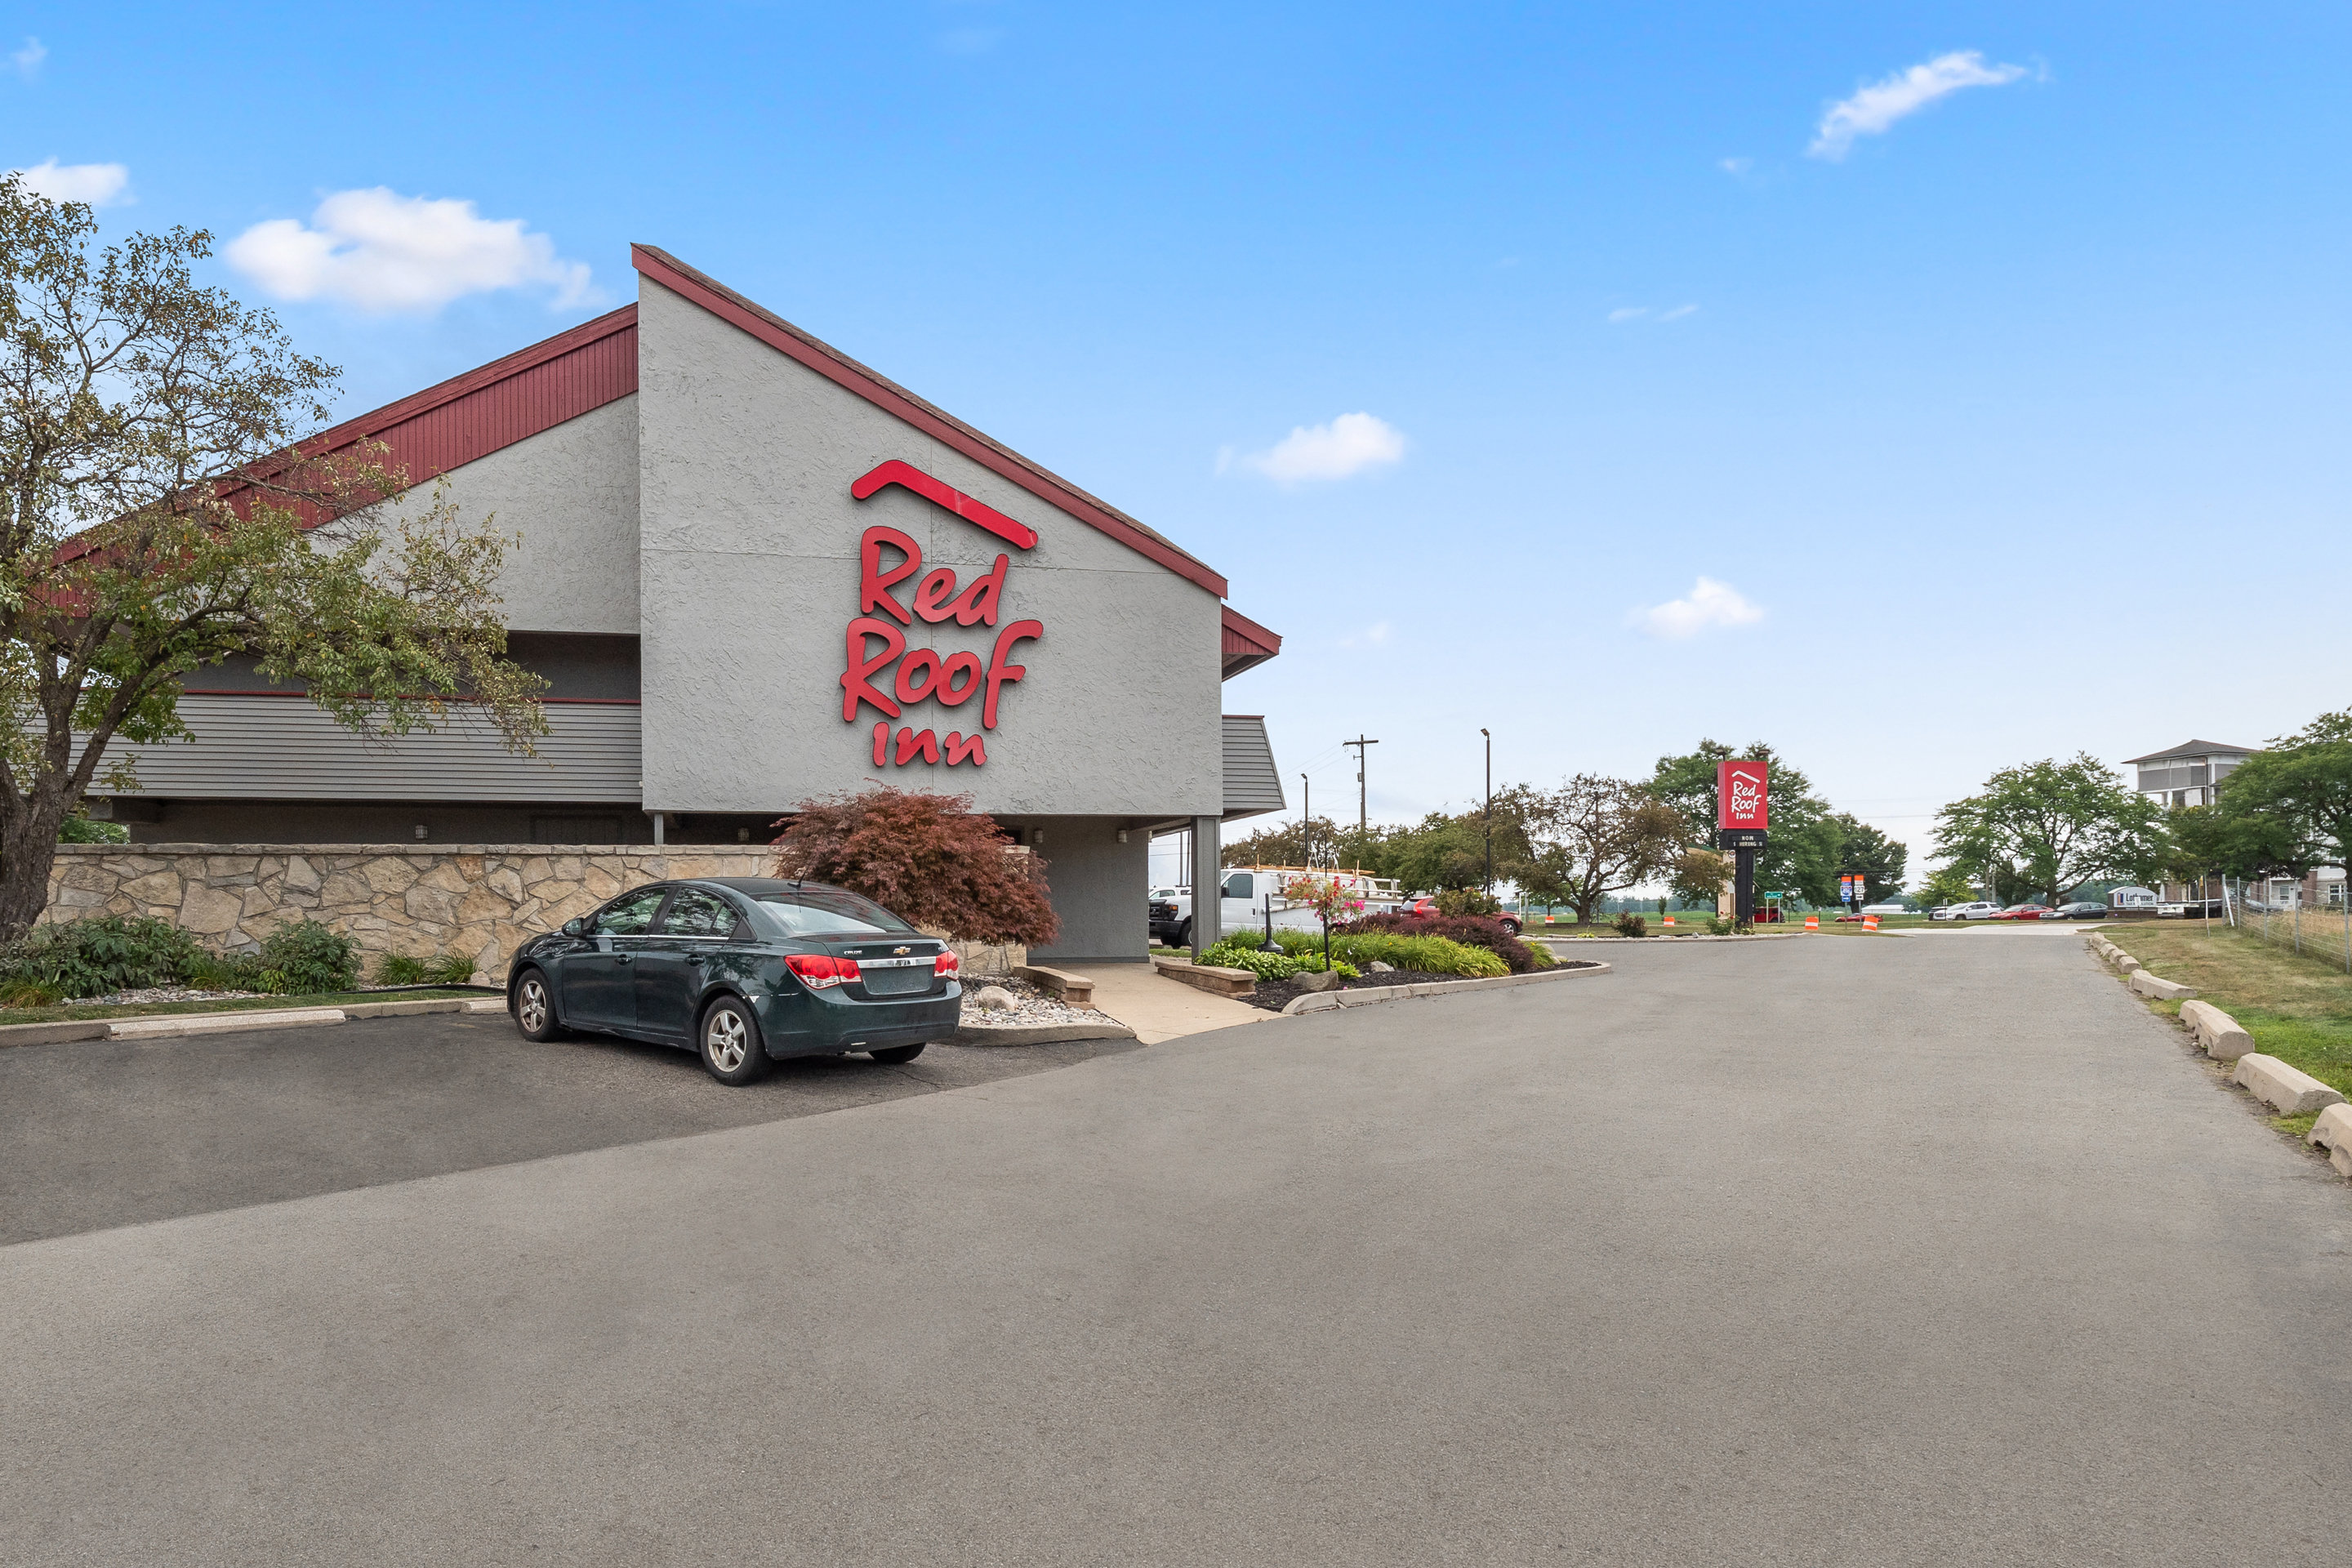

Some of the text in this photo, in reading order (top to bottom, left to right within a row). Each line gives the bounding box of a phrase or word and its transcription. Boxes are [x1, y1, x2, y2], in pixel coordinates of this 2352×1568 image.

[860, 525, 1009, 627] Red
[840, 617, 1044, 729] Roof
[1731, 795, 1762, 813] Roof
[1733, 781, 1757, 797] Red
